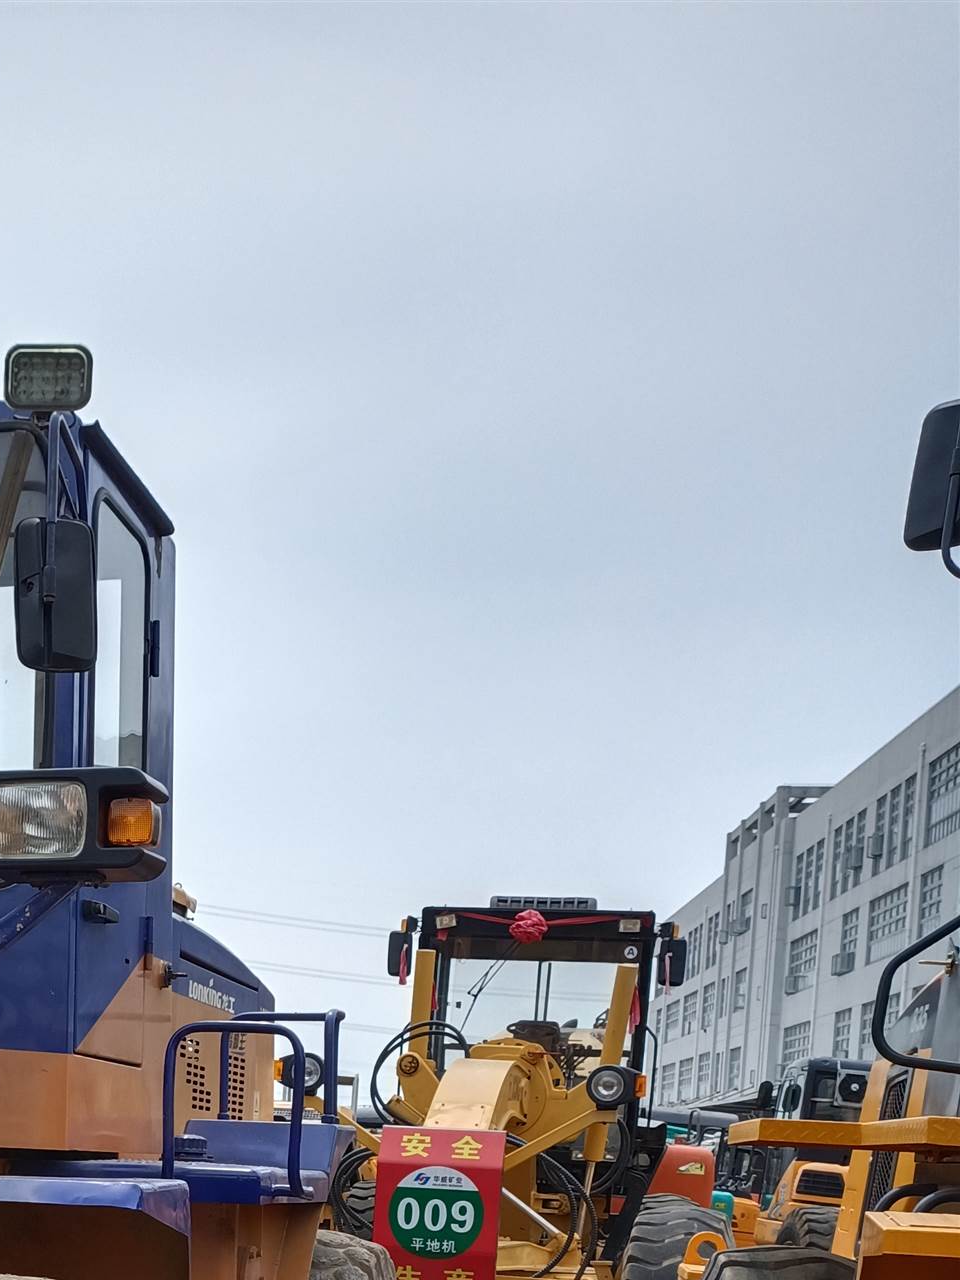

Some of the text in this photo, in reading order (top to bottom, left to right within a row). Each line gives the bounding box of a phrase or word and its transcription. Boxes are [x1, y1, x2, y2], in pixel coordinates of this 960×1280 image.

[401, 1132, 484, 1160] 安全
[397, 1197, 475, 1234] 009
[410, 1237, 457, 1254] 平地机
